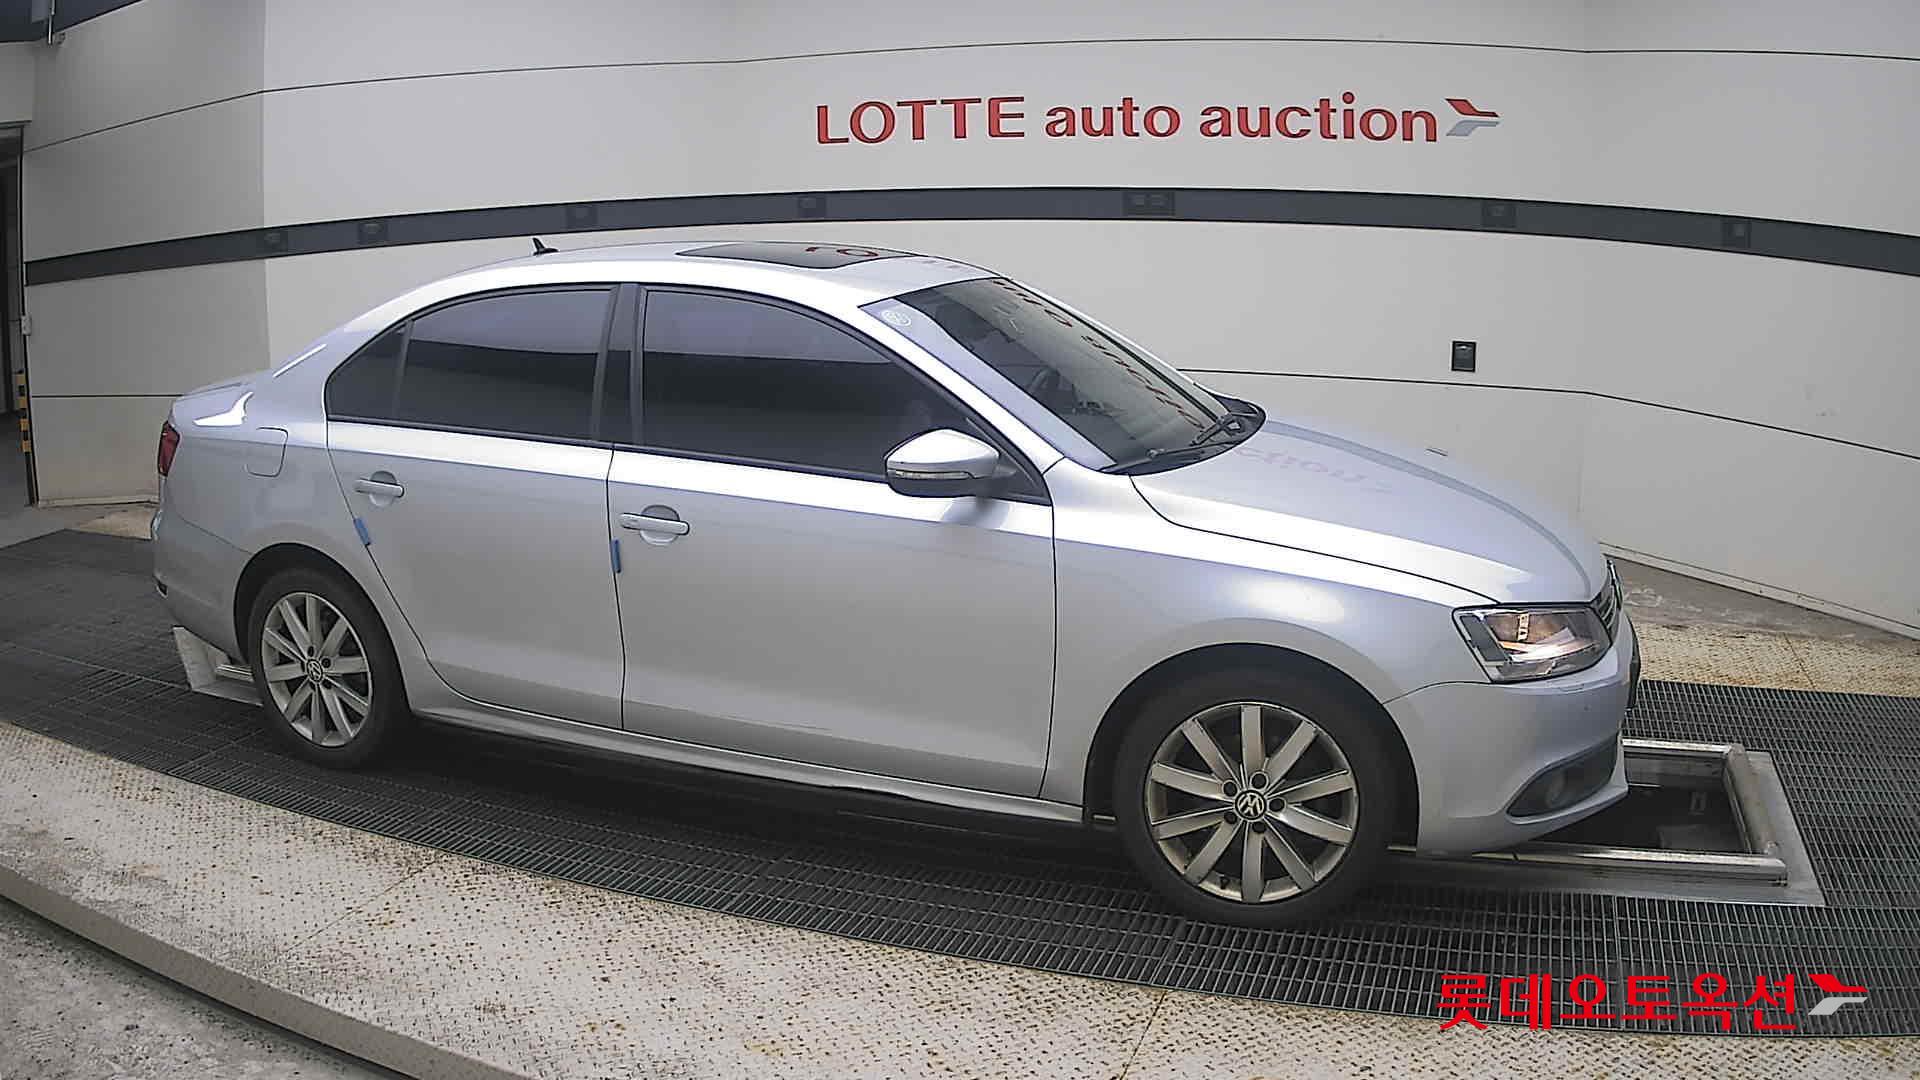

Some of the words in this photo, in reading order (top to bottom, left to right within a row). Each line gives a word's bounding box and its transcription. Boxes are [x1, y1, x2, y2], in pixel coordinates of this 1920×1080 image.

[816, 96, 1025, 144] LOTTE
[1044, 97, 1181, 139] auto
[1199, 91, 1438, 142] auction
